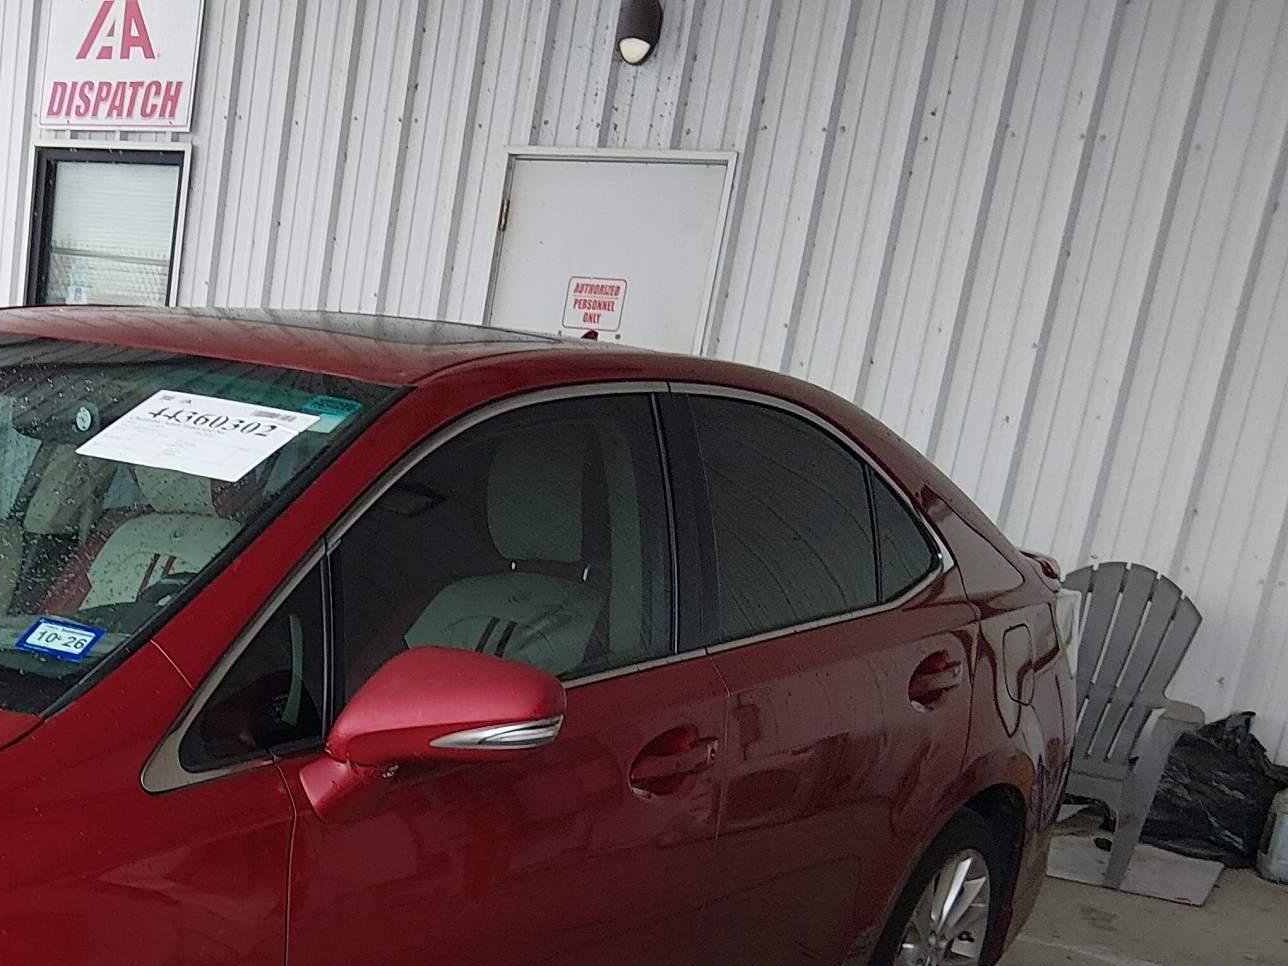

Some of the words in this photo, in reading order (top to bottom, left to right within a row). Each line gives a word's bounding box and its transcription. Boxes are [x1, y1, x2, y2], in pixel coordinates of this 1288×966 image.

[47, 80, 183, 119] DISPATCH
[573, 282, 621, 296] AUTHORIZED
[573, 299, 615, 312] PERSONNEL
[582, 311, 601, 324] ONLY
[148, 407, 277, 437] 44360302
